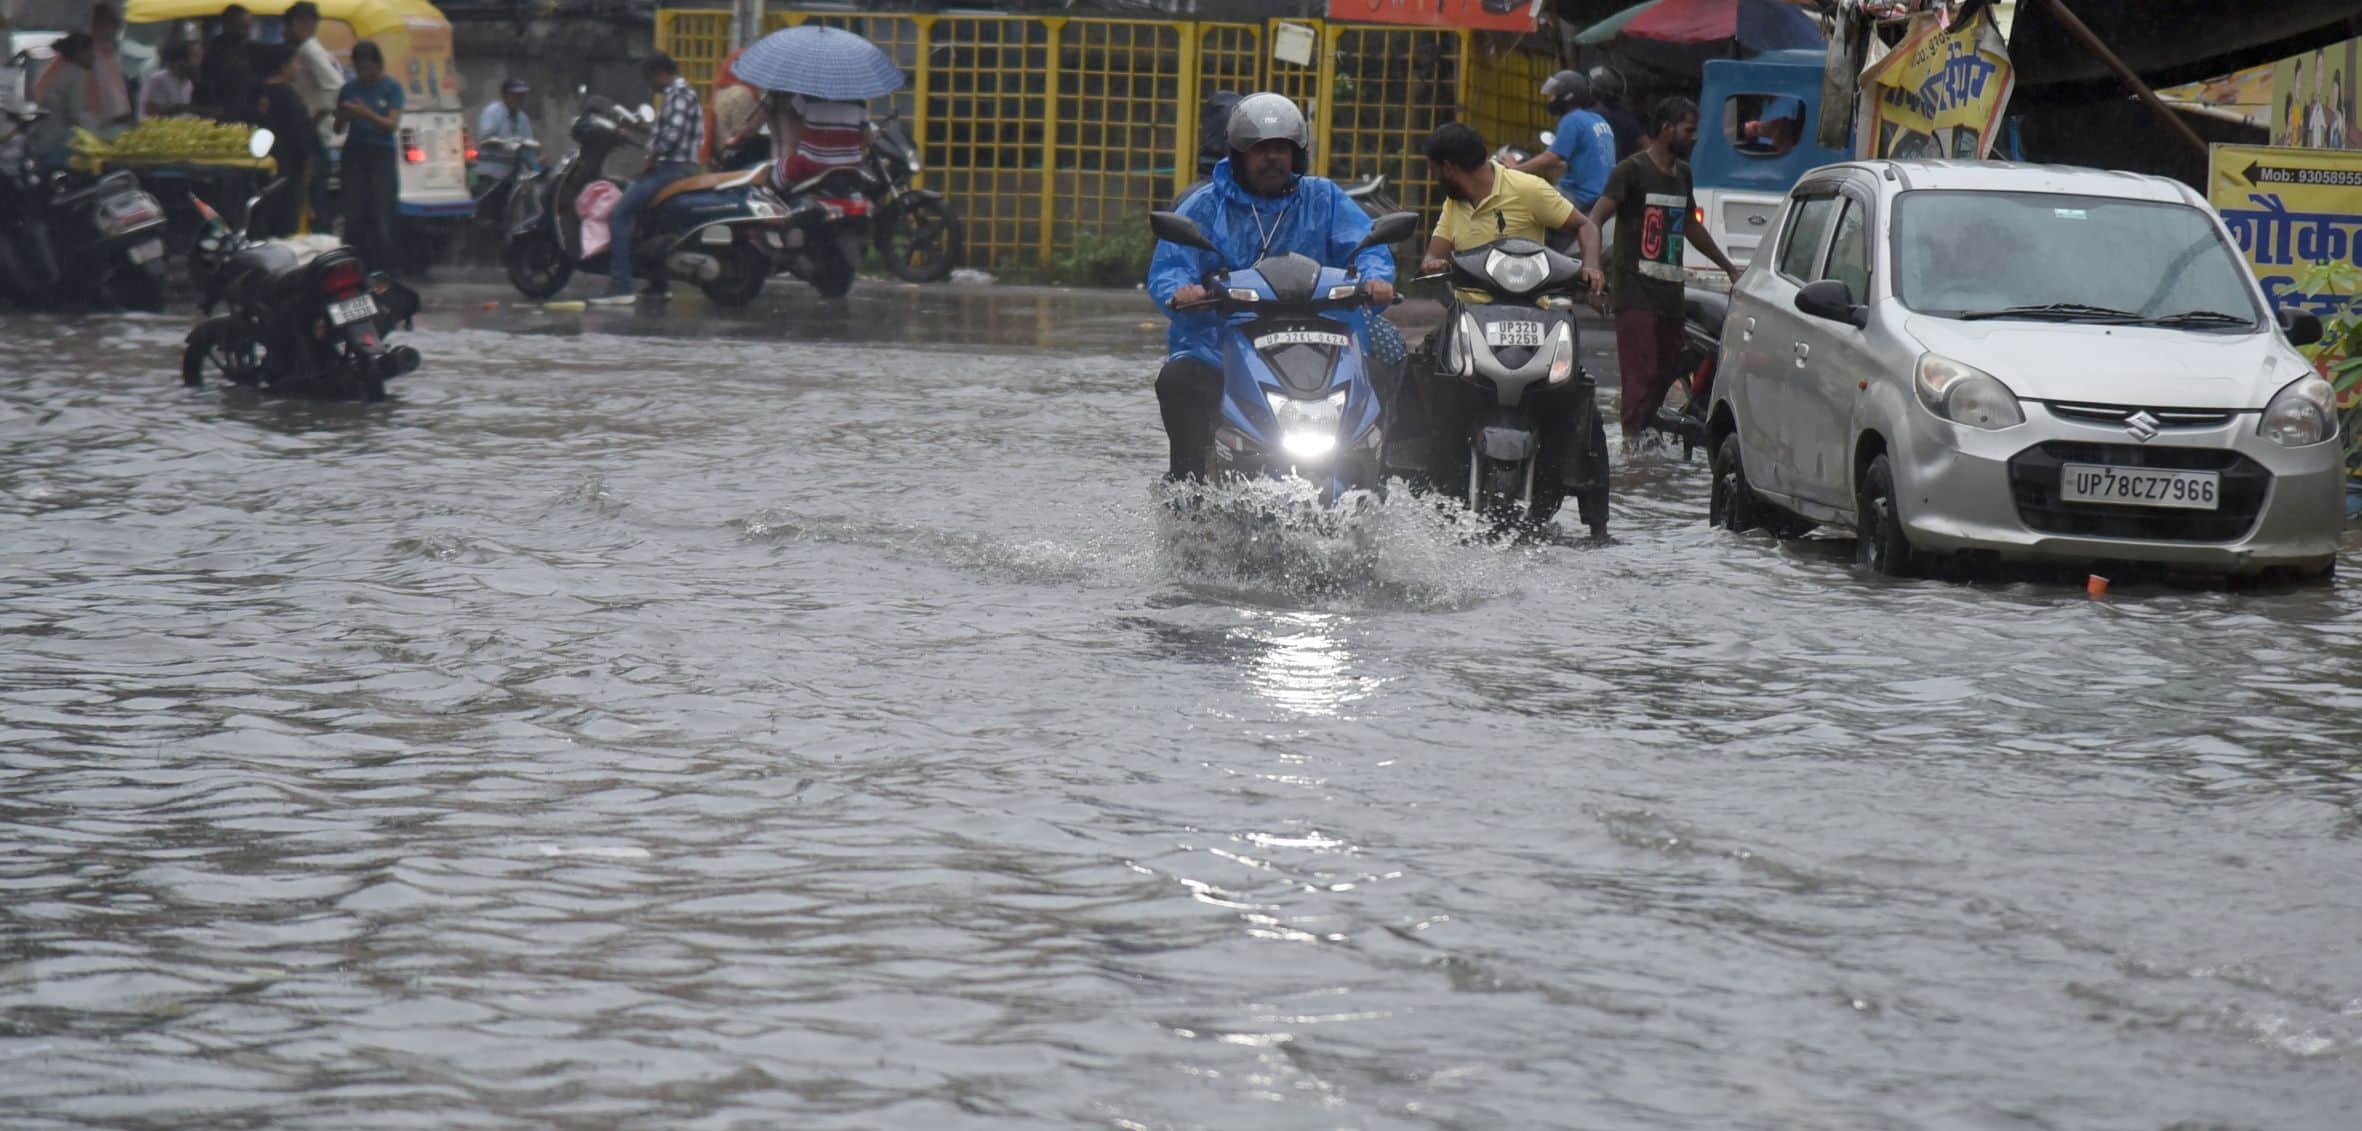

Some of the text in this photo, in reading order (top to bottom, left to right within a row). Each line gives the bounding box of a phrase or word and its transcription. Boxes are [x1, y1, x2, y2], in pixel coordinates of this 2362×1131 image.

[2260, 167, 2362, 185] Mob: 93058955
[2076, 472, 2214, 502] UP78CZ7966
